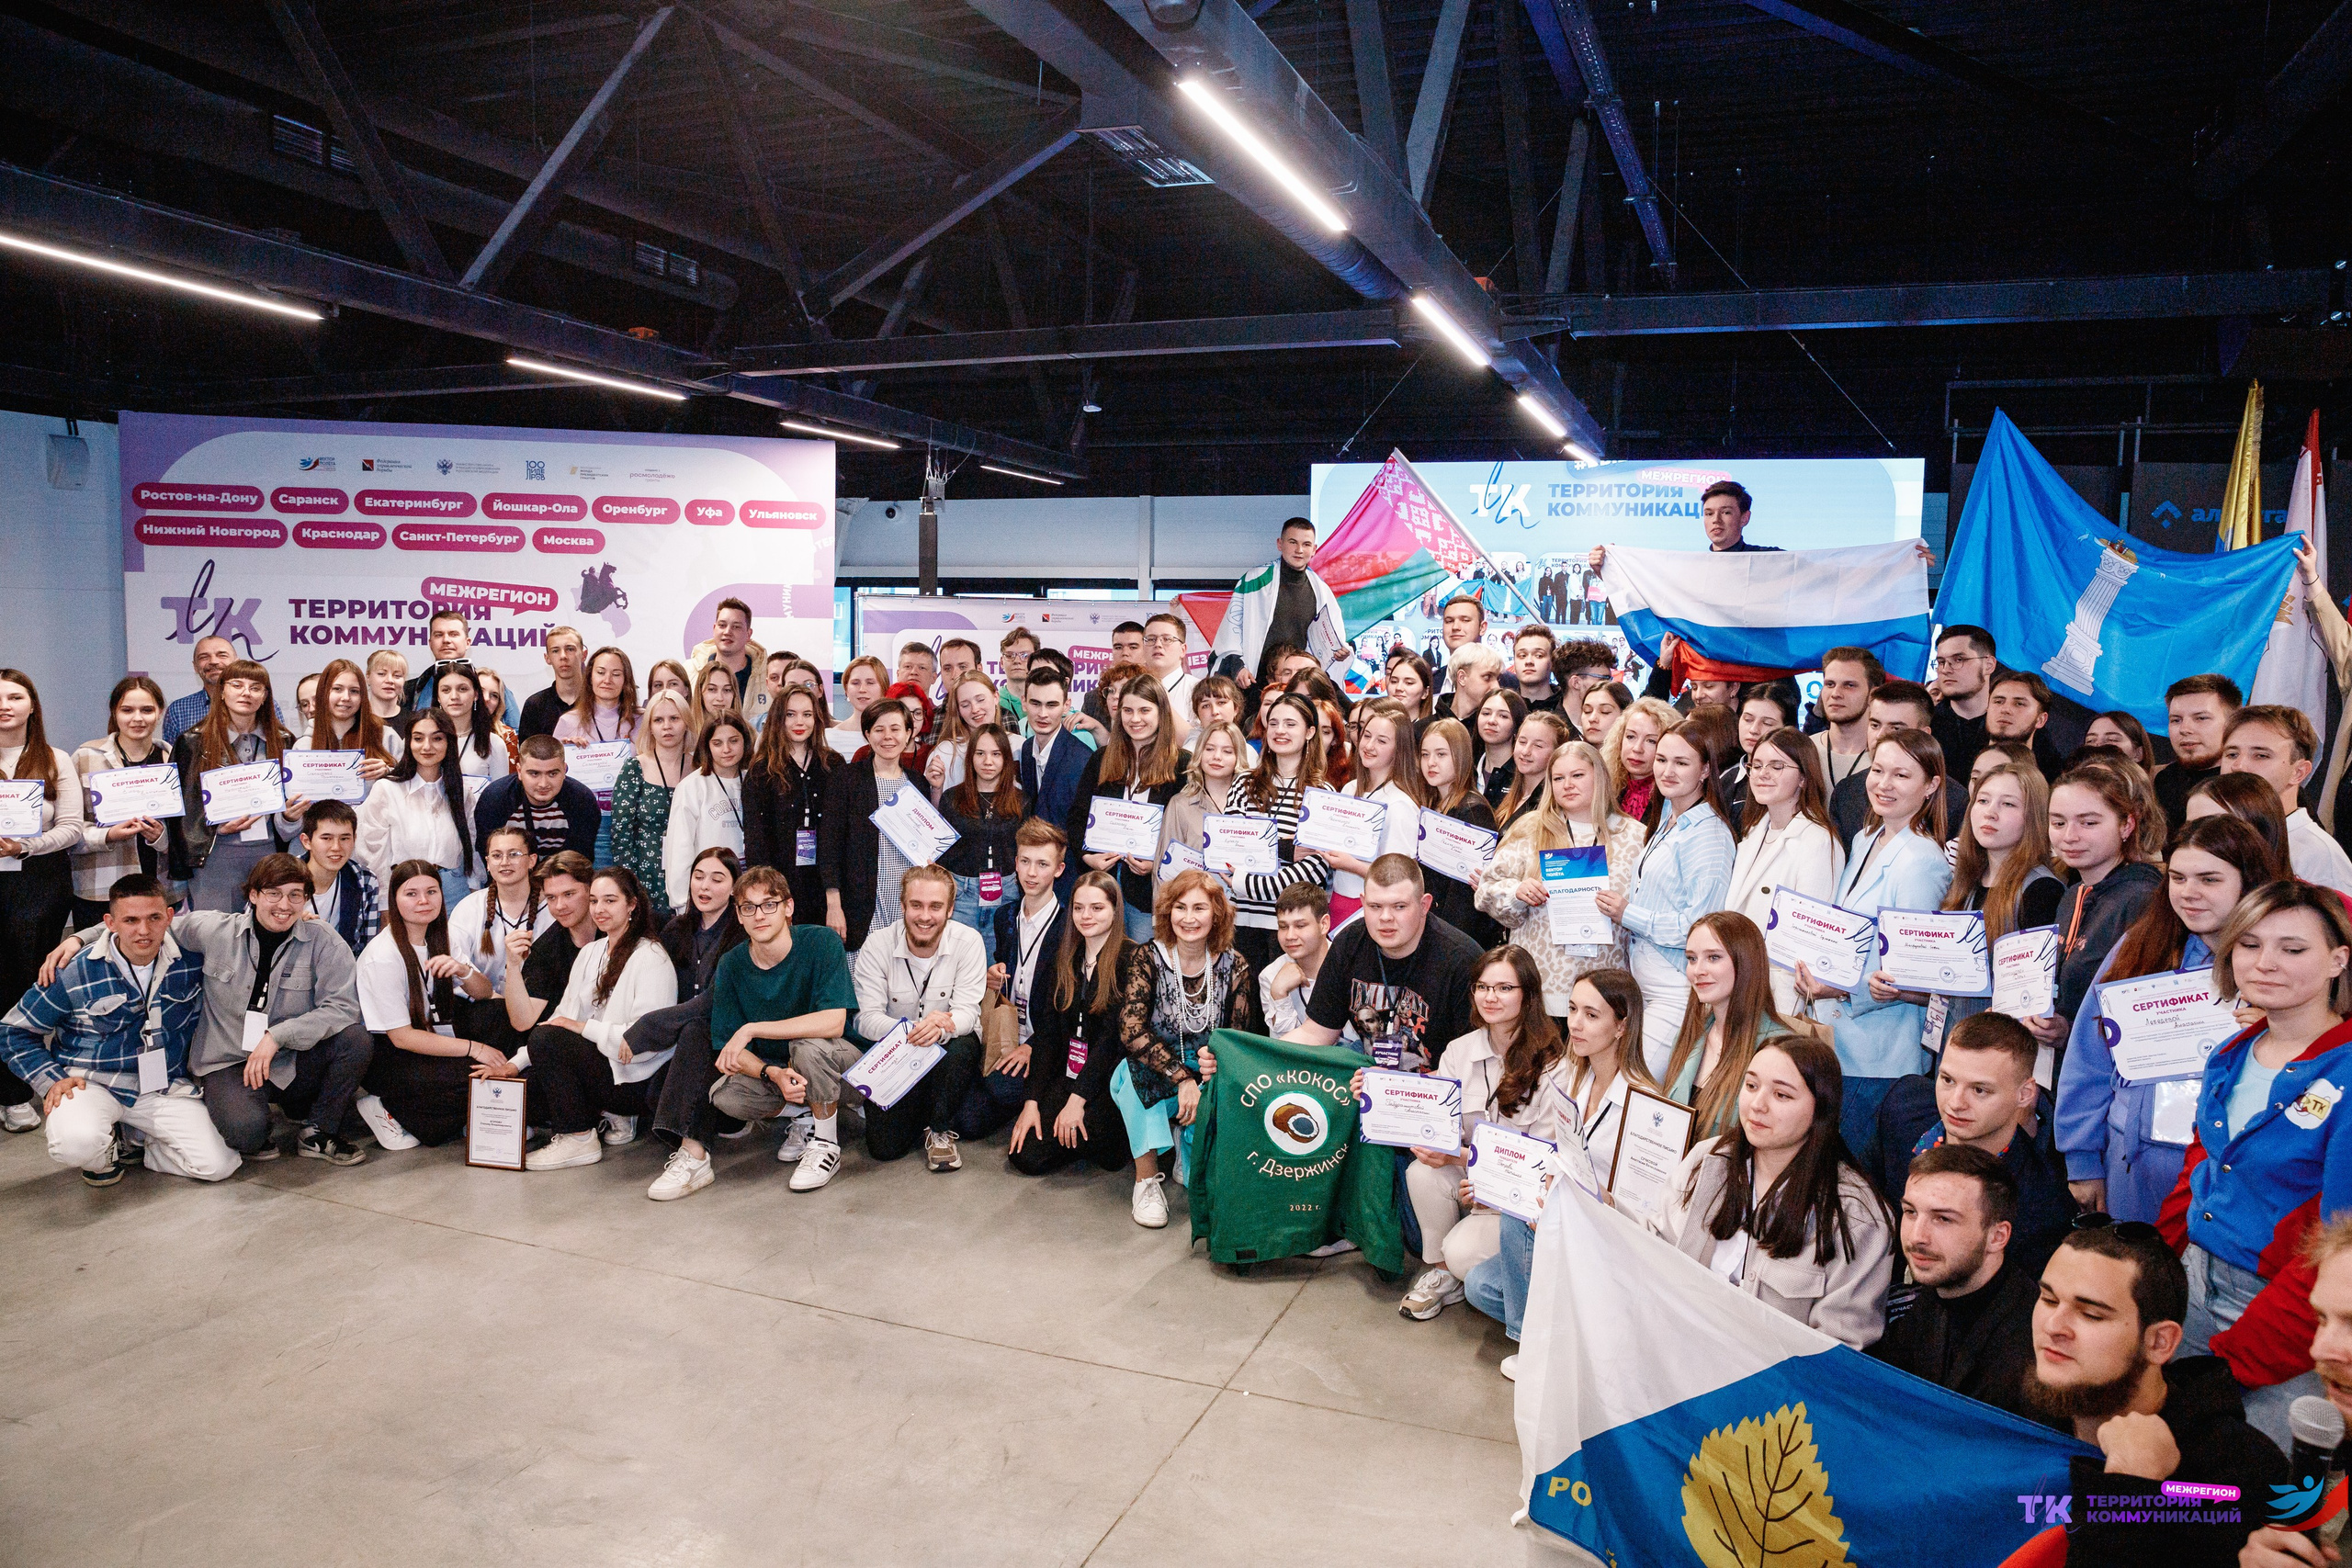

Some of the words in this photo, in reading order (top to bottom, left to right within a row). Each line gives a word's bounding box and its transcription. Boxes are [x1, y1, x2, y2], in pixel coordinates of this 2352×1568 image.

[526, 460, 545, 469] 100
[141, 490, 258, 505] Ростов-на-Дону
[1548, 483, 1683, 498] ТЕРРИТОРИЯ
[278, 493, 339, 506] Саранск
[365, 497, 463, 511] Екатеринбург
[492, 499, 579, 514] Йошкар-Ола
[602, 503, 668, 517] Оренбург
[696, 506, 723, 519] Уфа
[748, 509, 818, 521] Ульяновск
[142, 524, 206, 536] Нижний
[209, 525, 281, 539] Новгород
[301, 527, 380, 541] Краснодар
[399, 530, 520, 546] Санкт-Петербург
[543, 535, 594, 547] Москва
[429, 581, 551, 606] МЕЖРЕГИОН
[288, 623, 552, 649] КОММУНАЦИЙ
[576, 752, 615, 761] СЕРТИФИКАТ
[111, 777, 159, 788] СЕРТИФИКАТ
[219, 773, 261, 786] СЕРТИФИКАТ
[911, 807, 934, 830] ДИПЛОМ
[1104, 810, 1144, 821] СЕРТИФИКАТ
[1322, 805, 1366, 818] СЕРТИФИКАТ
[1435, 827, 1476, 846] СЕРТИФИКАТ
[1549, 886, 1602, 895] БЛАГОДАРНОСТЬ
[1792, 910, 1847, 934] СЕРТИФИКАТ
[1899, 929, 1955, 939] СЕРТИФИКАТ
[1998, 950, 2034, 966] СЕРТИФИКАТ
[2132, 991, 2210, 1012] СЕРТИФИКАТ
[2155, 1007, 2187, 1016] УЧАСТНИКА
[867, 1039, 903, 1075] СЕРТИФИКАТ
[1240, 1073, 1272, 1108] СПО
[1276, 1069, 1351, 1107] «КОКОС»
[1385, 1089, 1439, 1100] СЕРТИФИКАТ
[2312, 1100, 2326, 1114] ТК
[1629, 1131, 1663, 1148] БЛАГОДАРСТВЕННОЕ
[1663, 1145, 1678, 1155] ПИСЬМО
[1494, 1145, 1526, 1161] ДИПЛОМ
[1247, 1151, 1259, 1166] г.
[1259, 1143, 1350, 1181] Дзержинск
